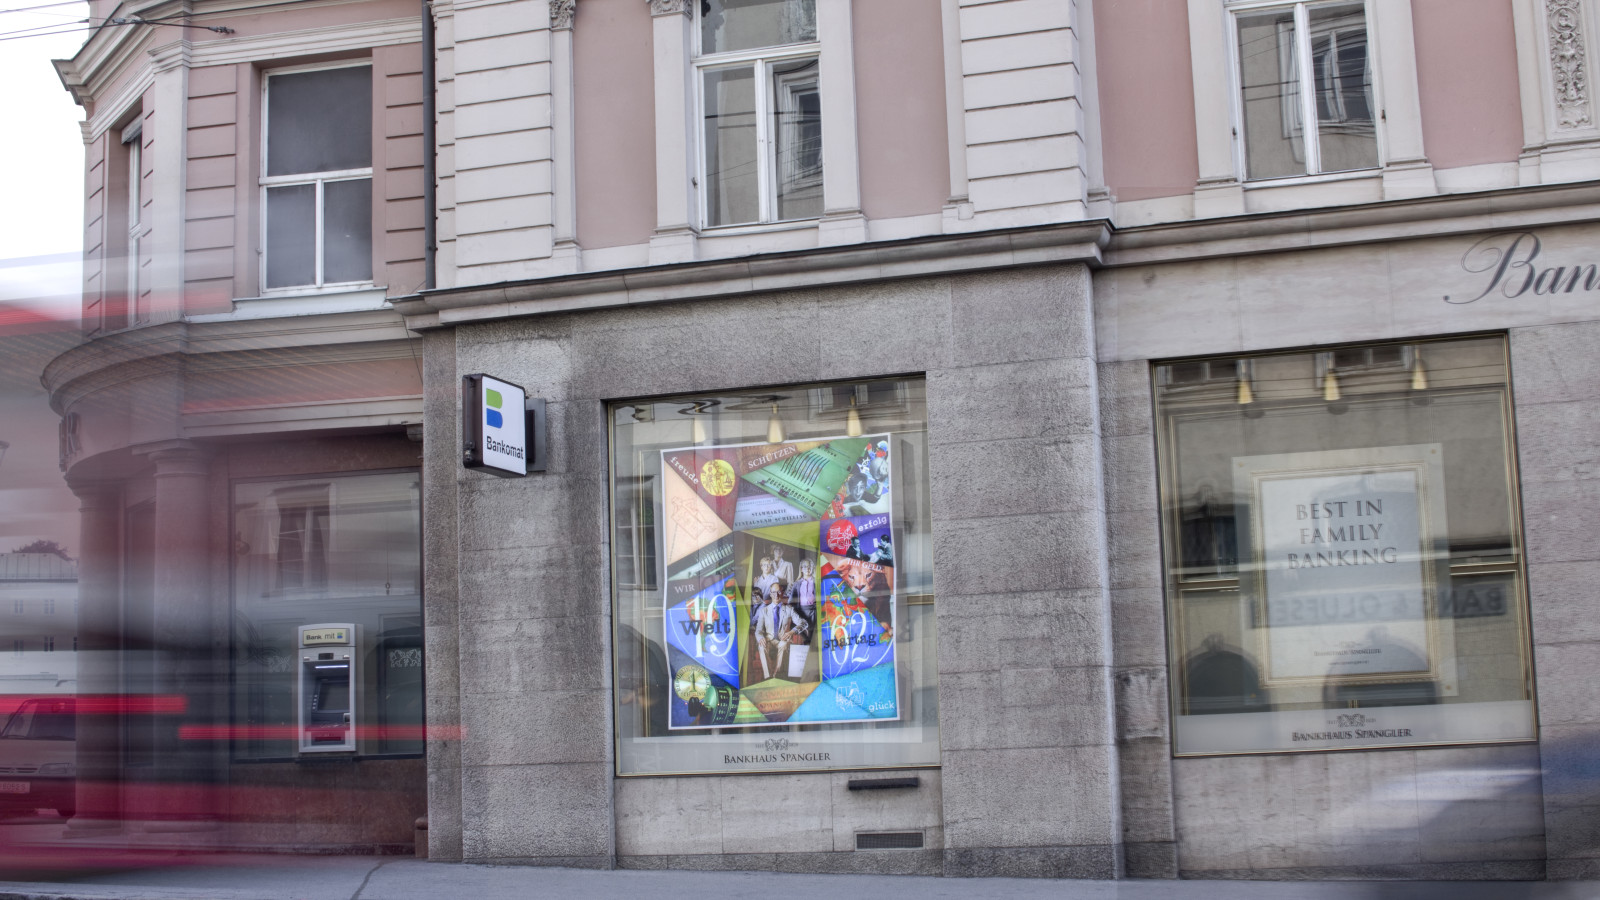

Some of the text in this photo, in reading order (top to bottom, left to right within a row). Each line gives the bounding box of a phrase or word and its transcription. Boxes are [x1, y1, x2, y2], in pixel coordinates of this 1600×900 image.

[1443, 231, 1600, 304] Ban
[487, 435, 524, 459] Bankomat
[747, 445, 797, 468] SCHÜTZEN
[670, 456, 698, 484] freude
[1295, 499, 1383, 520] BEST IN
[858, 516, 887, 531] erfolg
[1300, 523, 1383, 544] FAMILY
[1287, 547, 1398, 569] BANKING
[674, 583, 695, 593] WIR
[678, 618, 731, 636] Welt
[686, 594, 736, 657] 19
[823, 633, 877, 651] spartag
[831, 612, 870, 665] 62
[868, 700, 895, 712] glück
[1292, 730, 1352, 741] BANKHAUS
[724, 754, 777, 764] BANKHAUS
